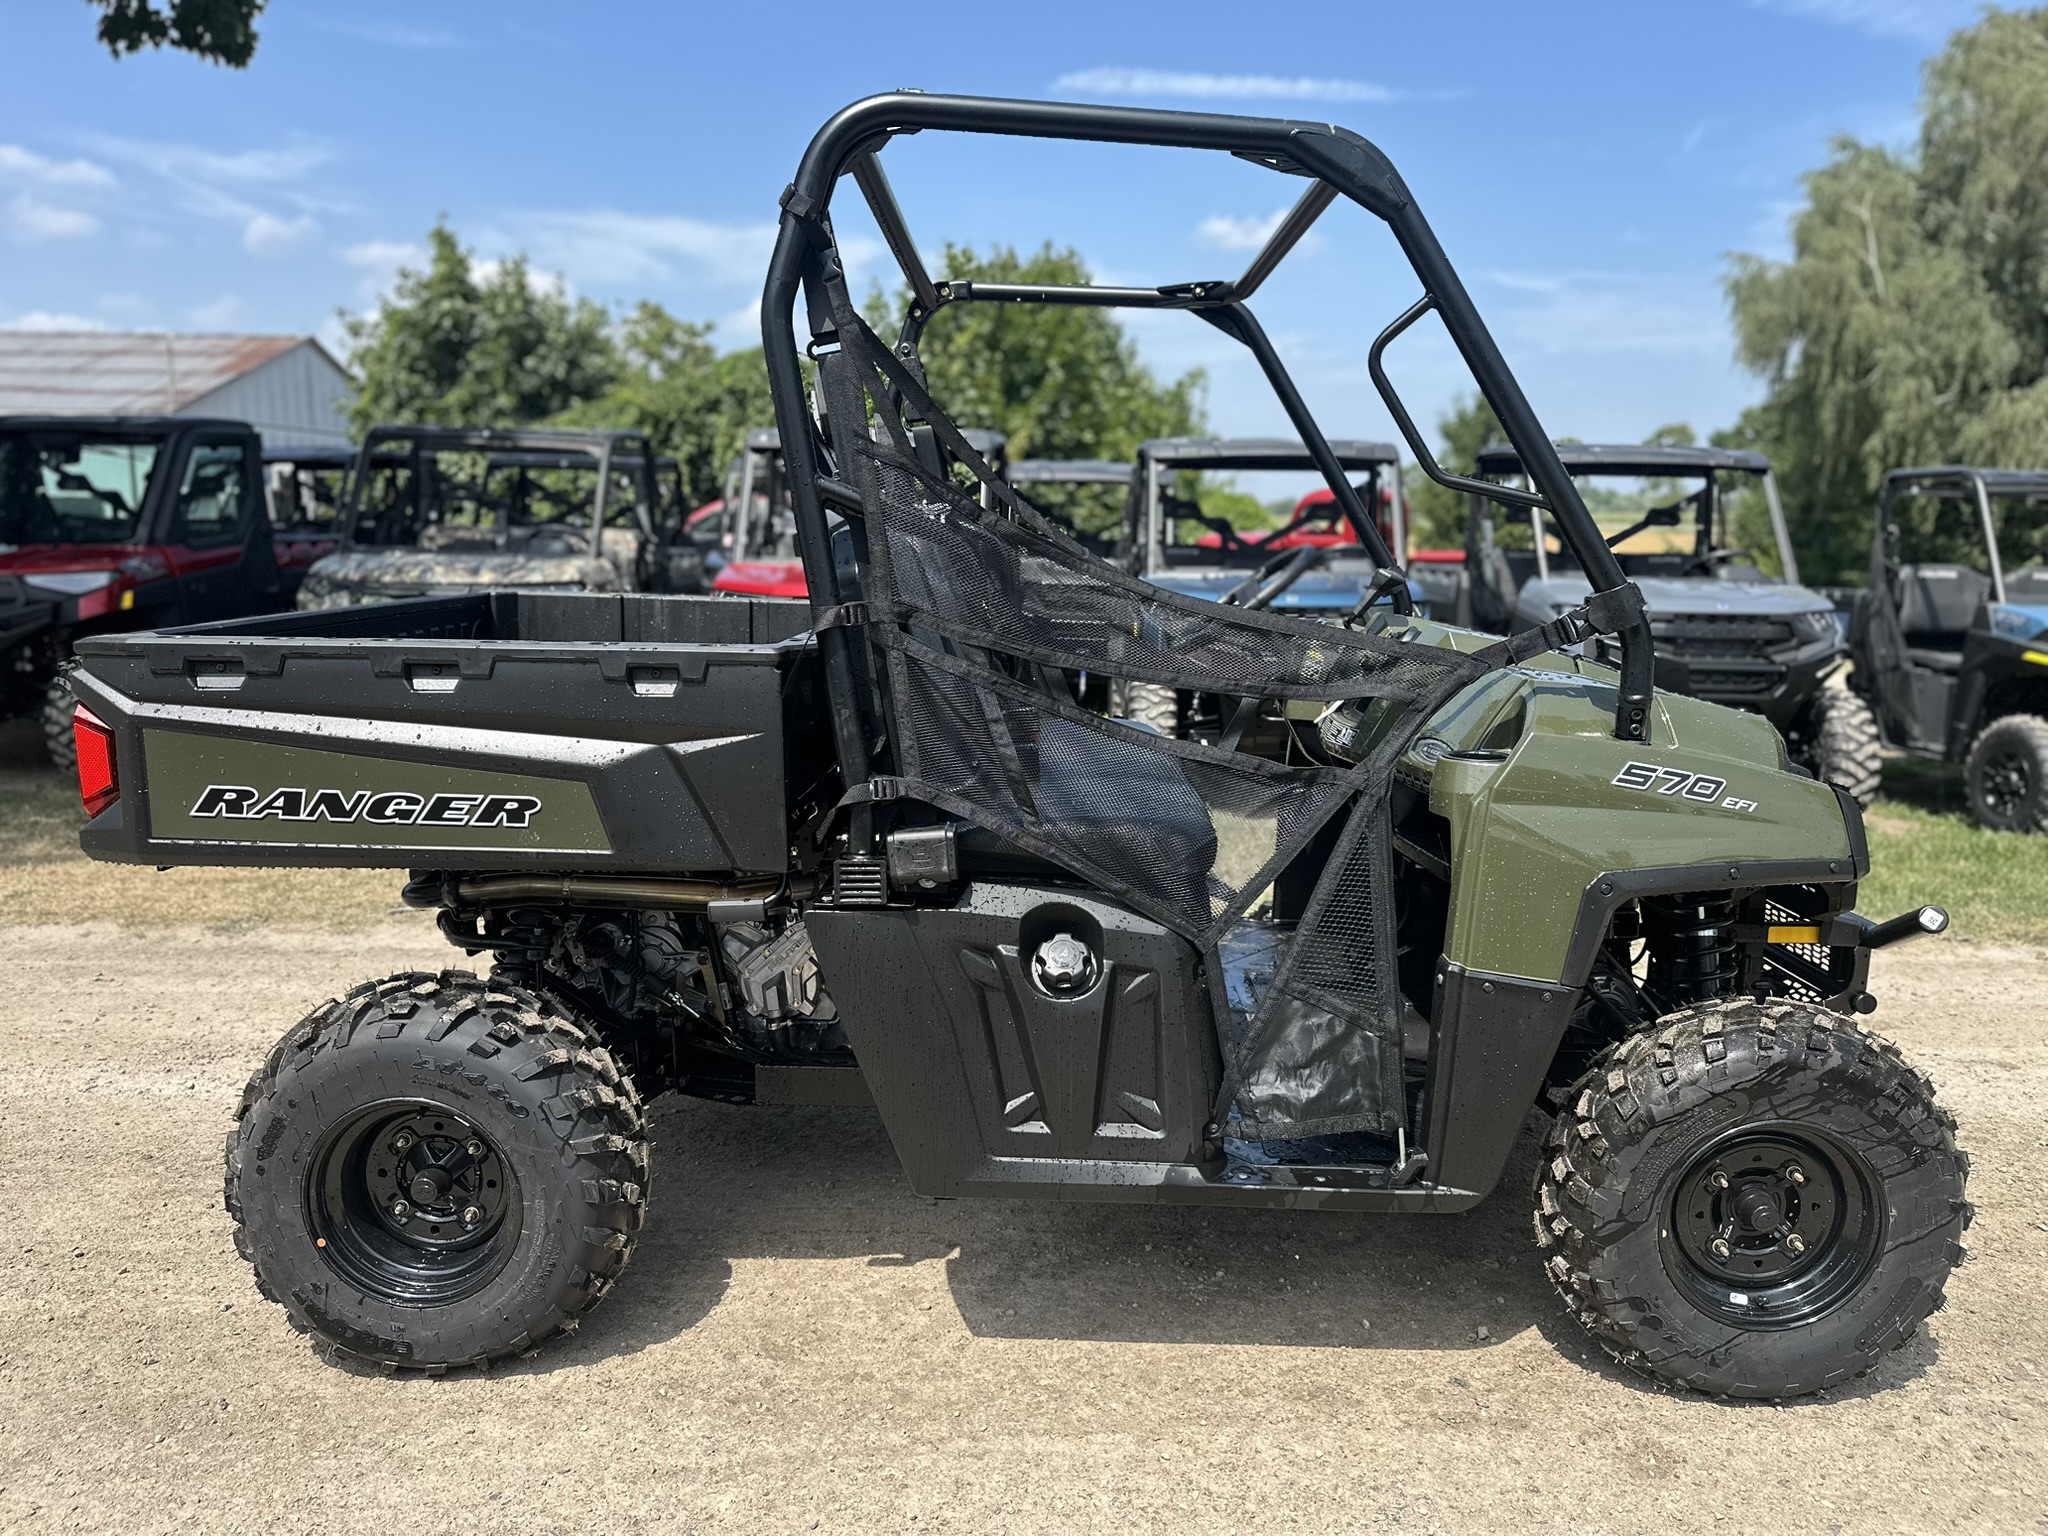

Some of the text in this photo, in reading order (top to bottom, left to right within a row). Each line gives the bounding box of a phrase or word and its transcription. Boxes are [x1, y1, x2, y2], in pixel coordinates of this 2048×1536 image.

[189, 784, 543, 827] RANGER
[1611, 761, 1758, 813] 570 EFI
